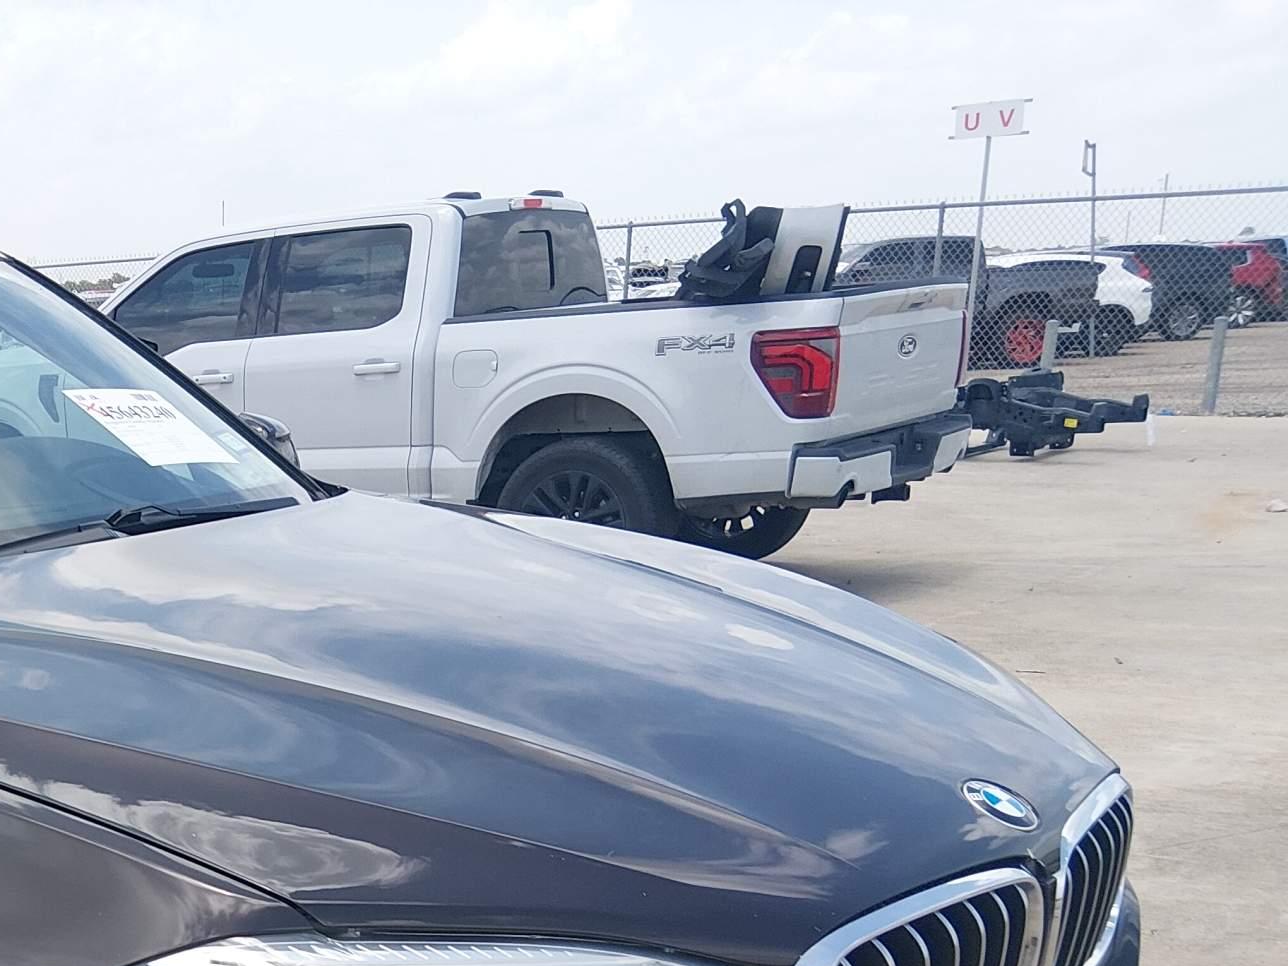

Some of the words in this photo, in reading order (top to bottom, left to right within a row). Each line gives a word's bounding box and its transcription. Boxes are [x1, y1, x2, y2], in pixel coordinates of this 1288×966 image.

[964, 112, 980, 131] U
[999, 108, 1015, 127] V
[655, 332, 736, 357] FX4
